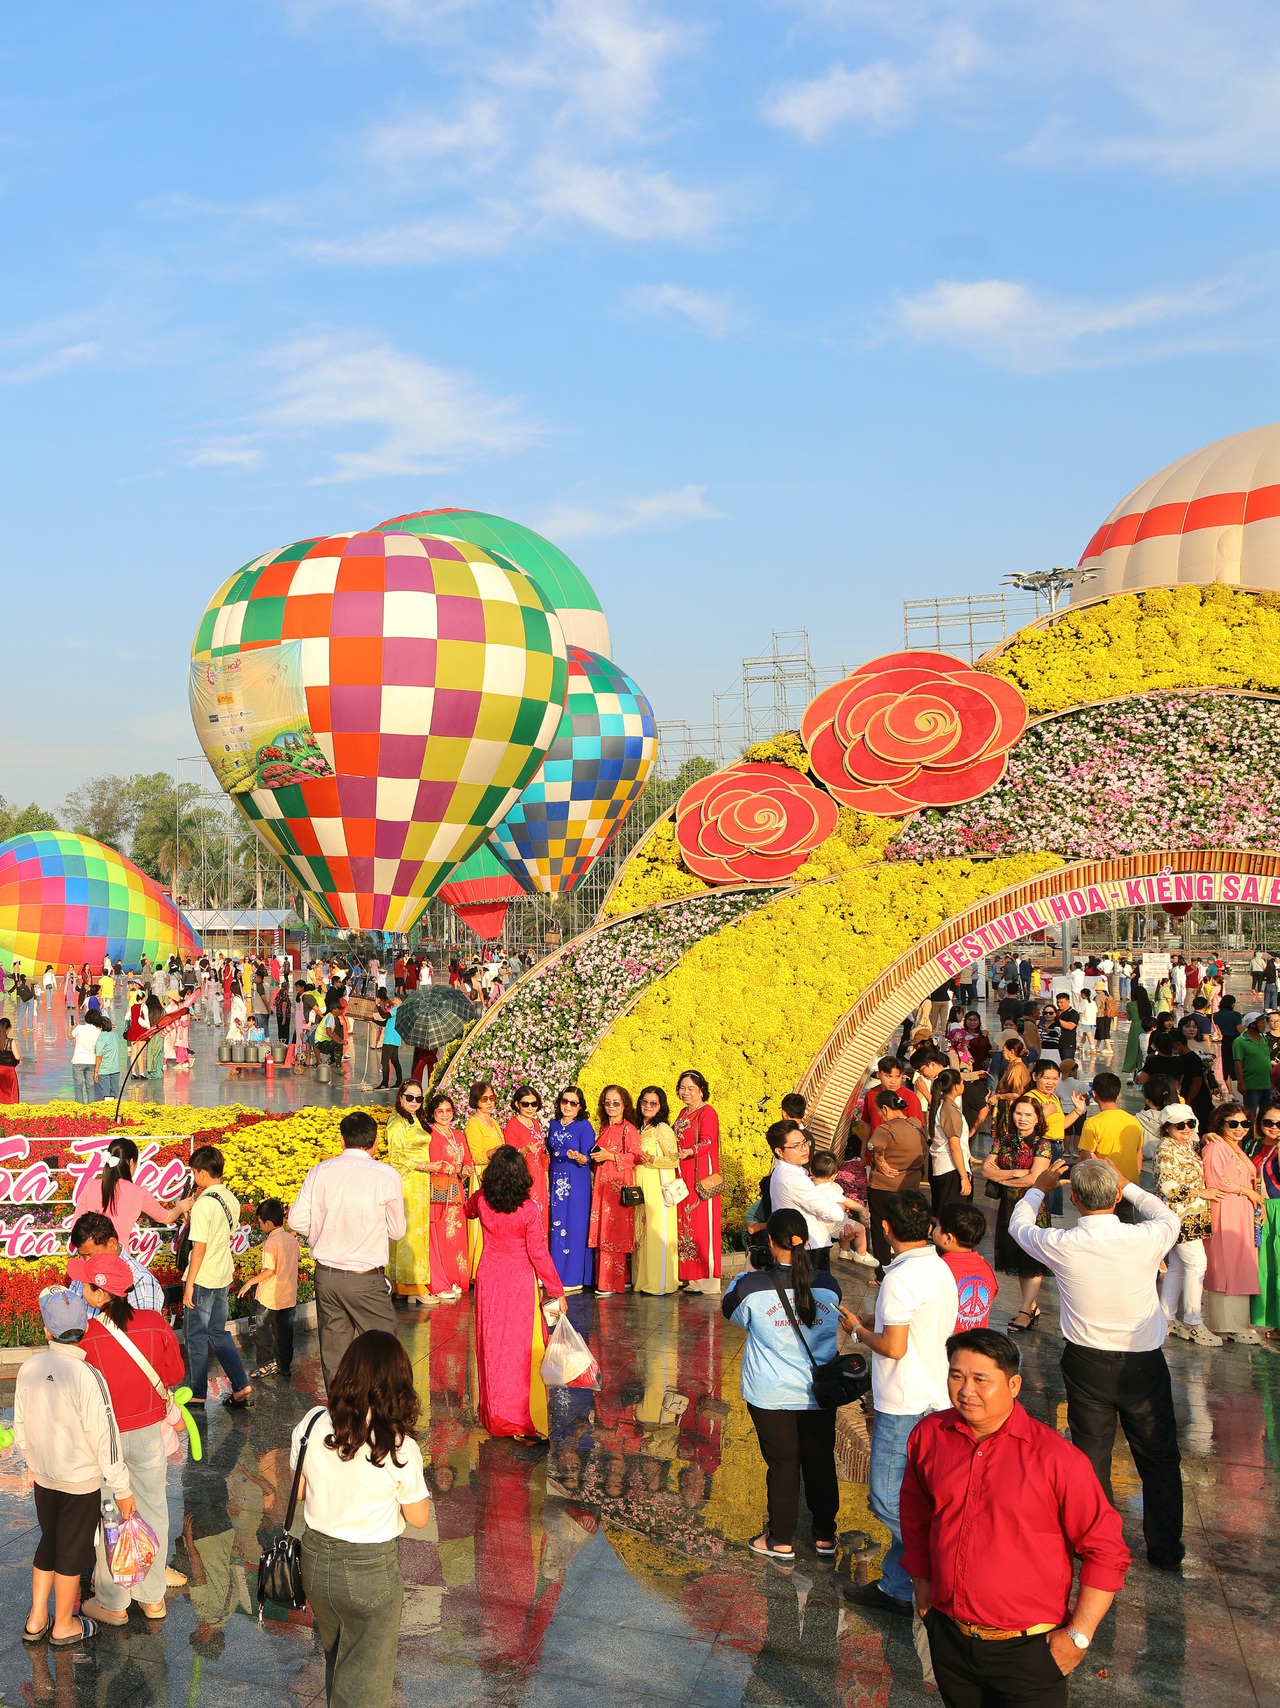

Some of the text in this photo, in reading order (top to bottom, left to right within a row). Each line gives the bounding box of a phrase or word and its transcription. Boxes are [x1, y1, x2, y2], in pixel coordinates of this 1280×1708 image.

[935, 906, 1049, 977] FESTIVAL
[1049, 886, 1108, 922] HOA
[1125, 866, 1214, 906] KIỂNG
[1222, 874, 1260, 903] SA
